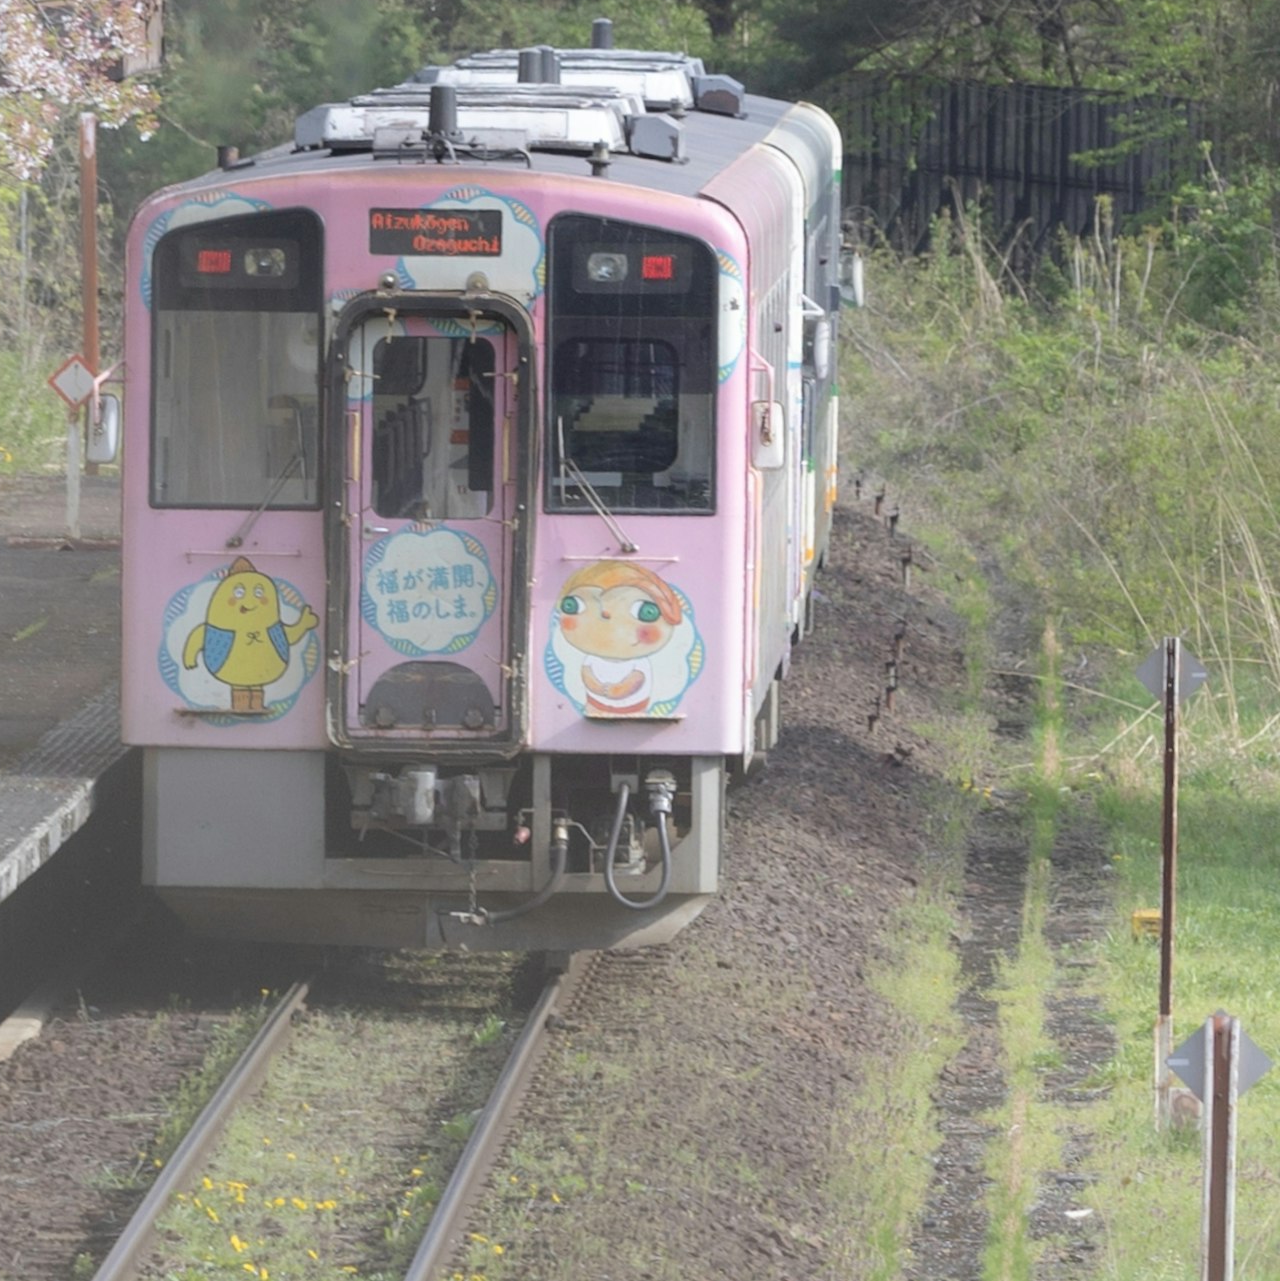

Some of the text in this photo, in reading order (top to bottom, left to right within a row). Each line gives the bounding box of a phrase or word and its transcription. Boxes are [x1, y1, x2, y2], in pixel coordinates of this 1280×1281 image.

[376, 563, 484, 595] 福が満開、
[386, 595, 477, 624] 福のしま。
